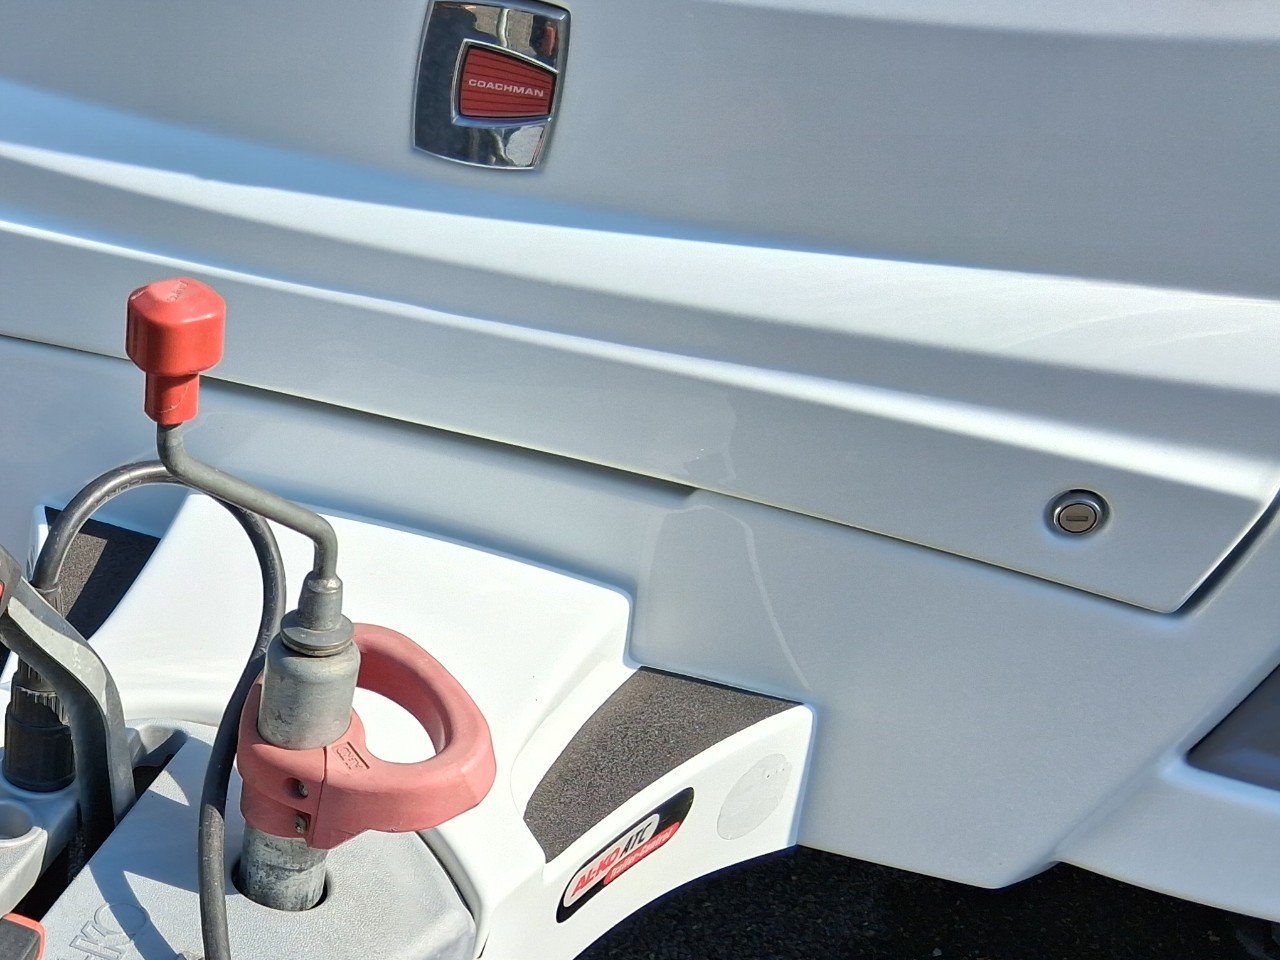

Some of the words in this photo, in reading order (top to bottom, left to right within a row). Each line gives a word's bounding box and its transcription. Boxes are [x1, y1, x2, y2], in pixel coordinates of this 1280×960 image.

[468, 78, 544, 97] COACHMAN
[570, 847, 621, 898] AL-KO
[619, 821, 653, 857] ATC
